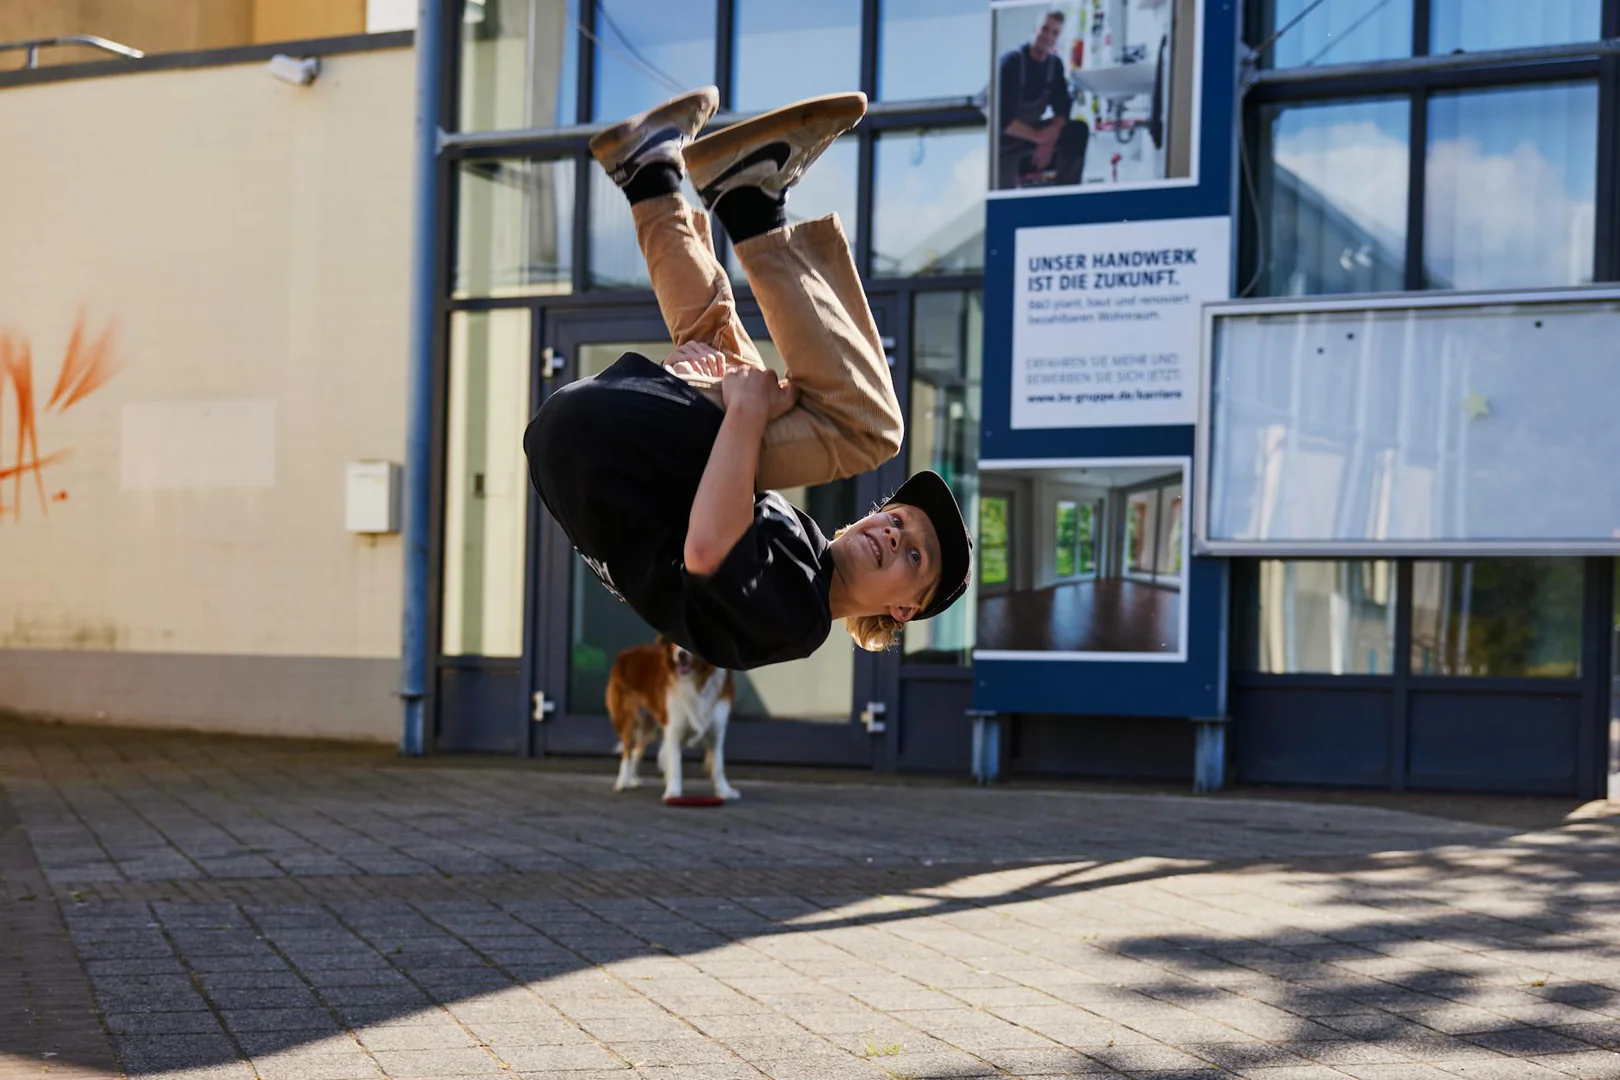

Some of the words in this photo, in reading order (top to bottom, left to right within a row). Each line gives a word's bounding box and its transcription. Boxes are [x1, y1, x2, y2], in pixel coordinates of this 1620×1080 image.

[1029, 254, 1086, 272] UNSER
[1093, 248, 1197, 268] HANDWERK
[1028, 276, 1053, 292] IST
[1060, 274, 1087, 290] DIE
[1094, 270, 1179, 289] ZUKUNFT.
[1117, 295, 1135, 306] und
